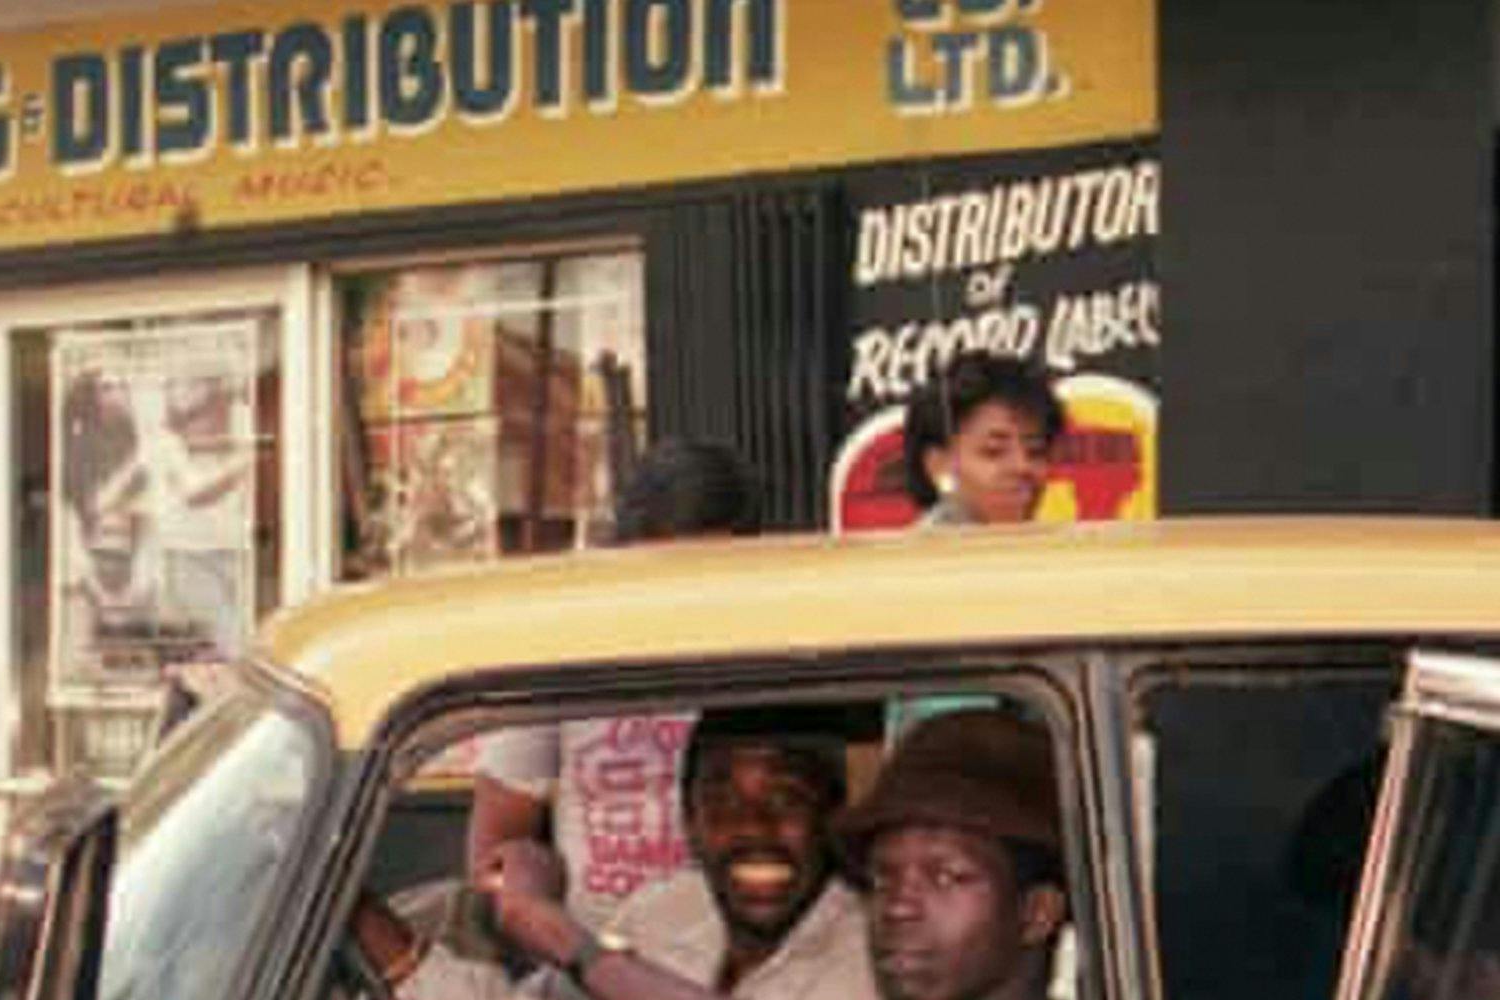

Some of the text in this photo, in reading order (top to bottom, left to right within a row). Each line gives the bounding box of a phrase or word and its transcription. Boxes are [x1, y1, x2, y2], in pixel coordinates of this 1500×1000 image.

[50, 0, 786, 175] DISTRIBUTION
[884, 27, 1073, 117] LTD.
[853, 161, 1161, 286] DISTRIBUTOR
